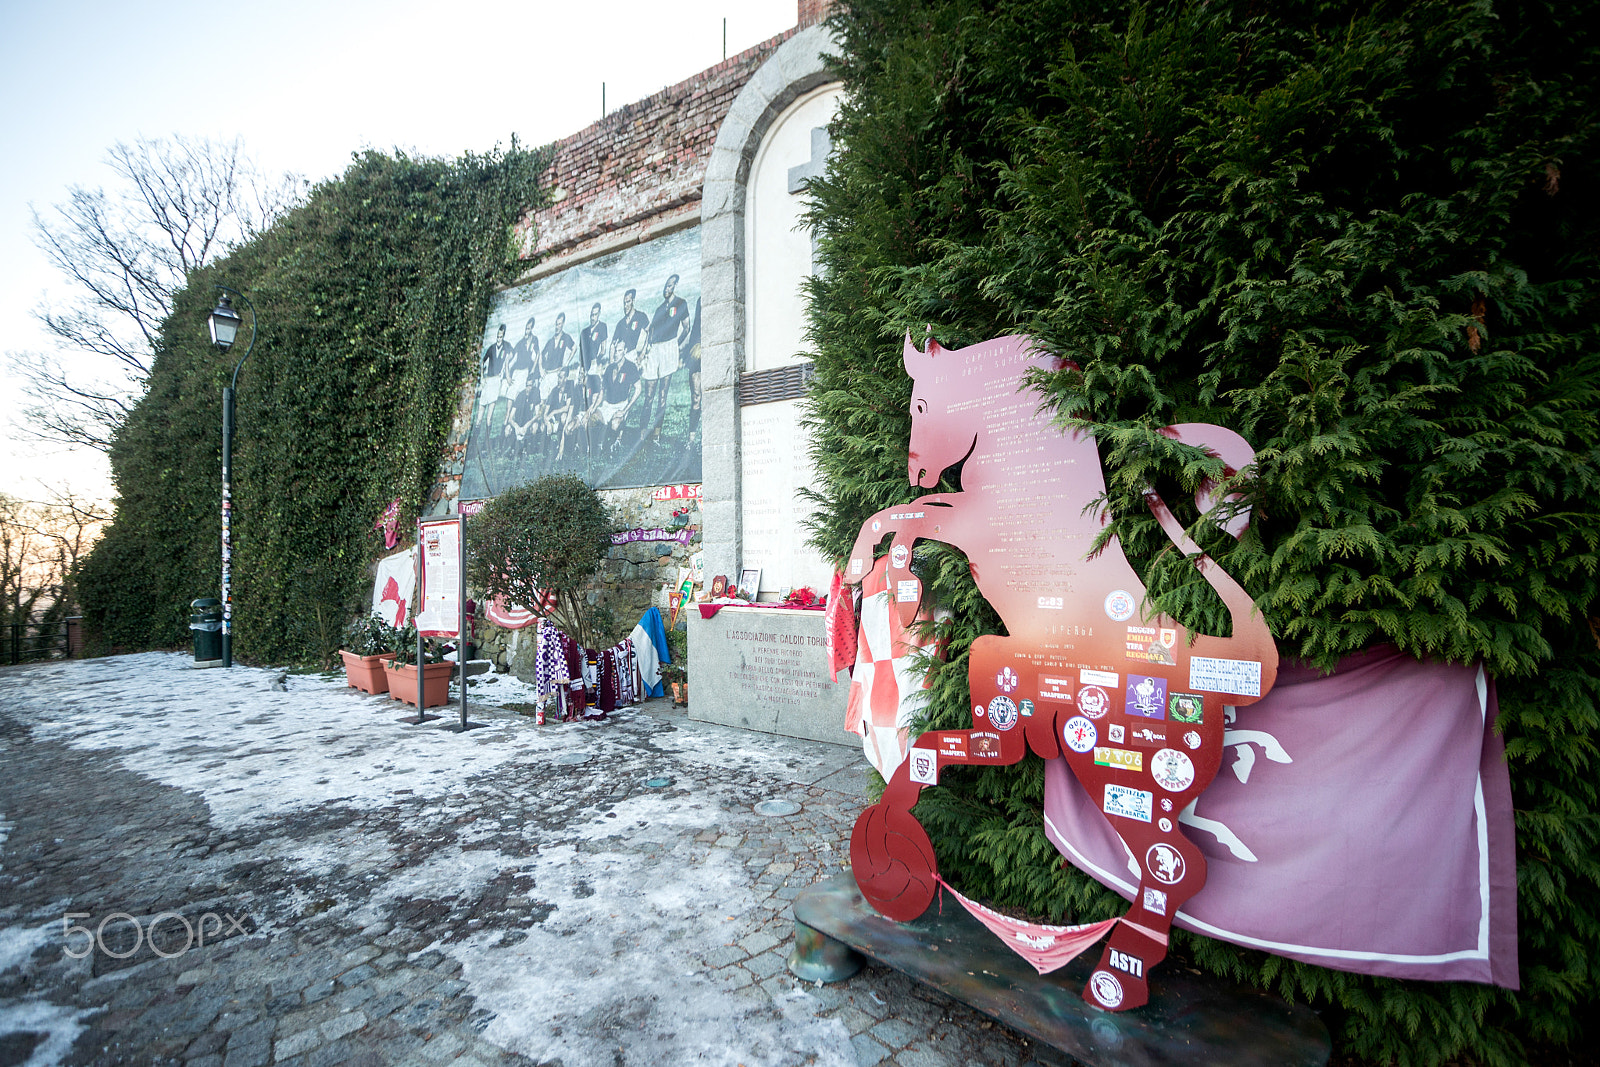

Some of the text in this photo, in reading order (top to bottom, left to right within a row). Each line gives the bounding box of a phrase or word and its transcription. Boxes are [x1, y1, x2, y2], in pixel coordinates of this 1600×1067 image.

[1127, 626, 1156, 634] REGGIO
[780, 634, 804, 646] CALCIO
[1127, 634, 1153, 642] EMILIA
[1126, 651, 1164, 661] REGGIANA
[1069, 720, 1095, 737] QUINTO
[1157, 751, 1188, 764] BANDA
[1110, 950, 1142, 978] ASTI
